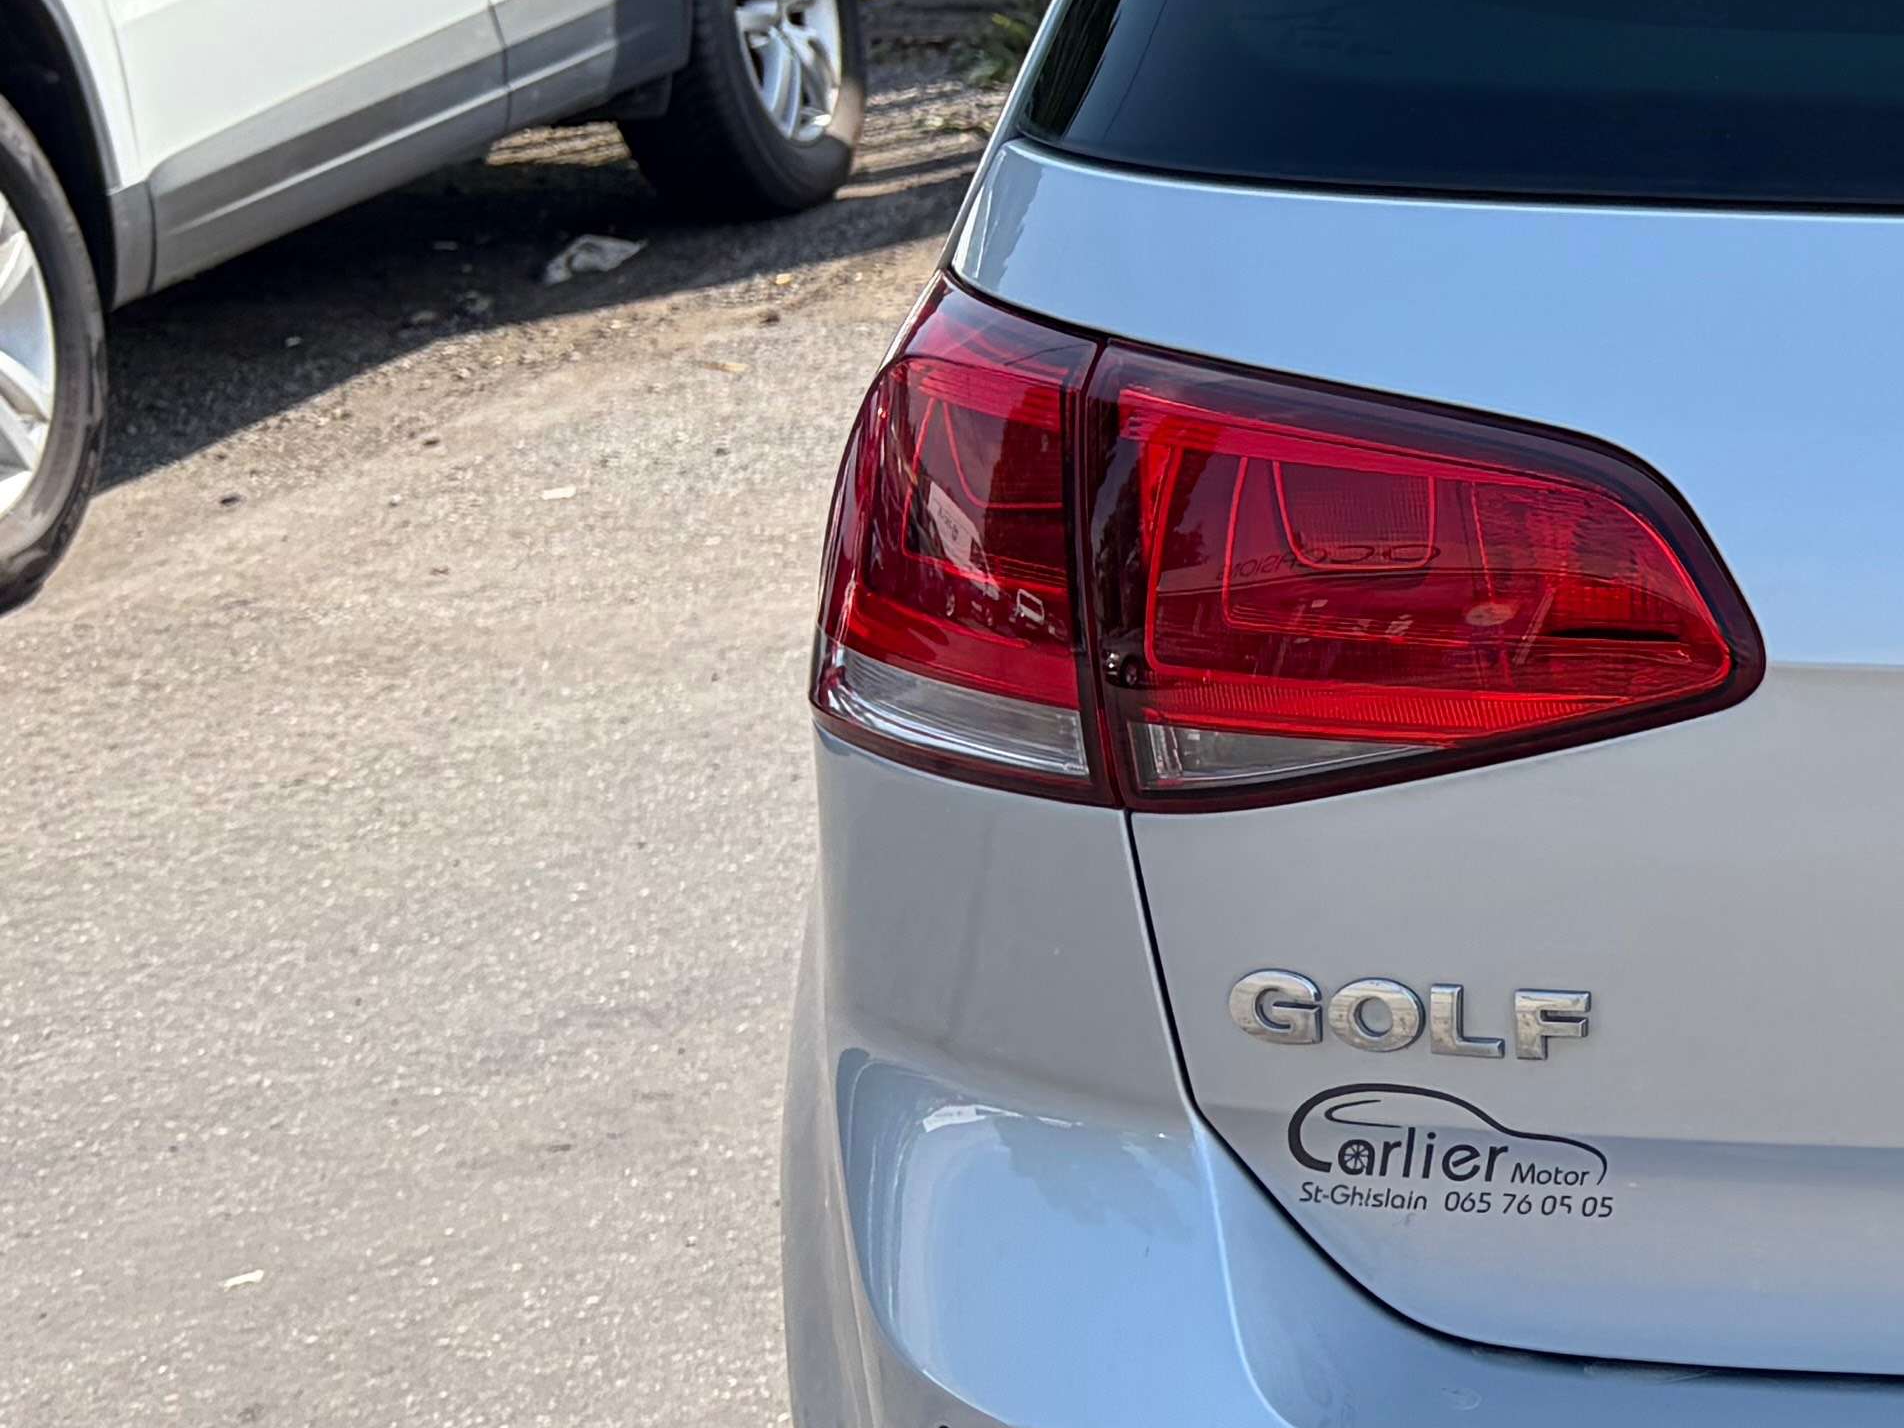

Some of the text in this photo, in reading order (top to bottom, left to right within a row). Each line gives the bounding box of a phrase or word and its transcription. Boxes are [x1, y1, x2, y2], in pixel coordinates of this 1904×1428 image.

[1227, 968, 1593, 1061] GOLF
[1510, 1162, 1590, 1186] Motor
[1299, 1181, 1428, 1211] St-Ghislain
[1443, 1190, 1492, 1214] 065
[1502, 1192, 1532, 1215] 76
[1581, 1196, 1614, 1217] 05
